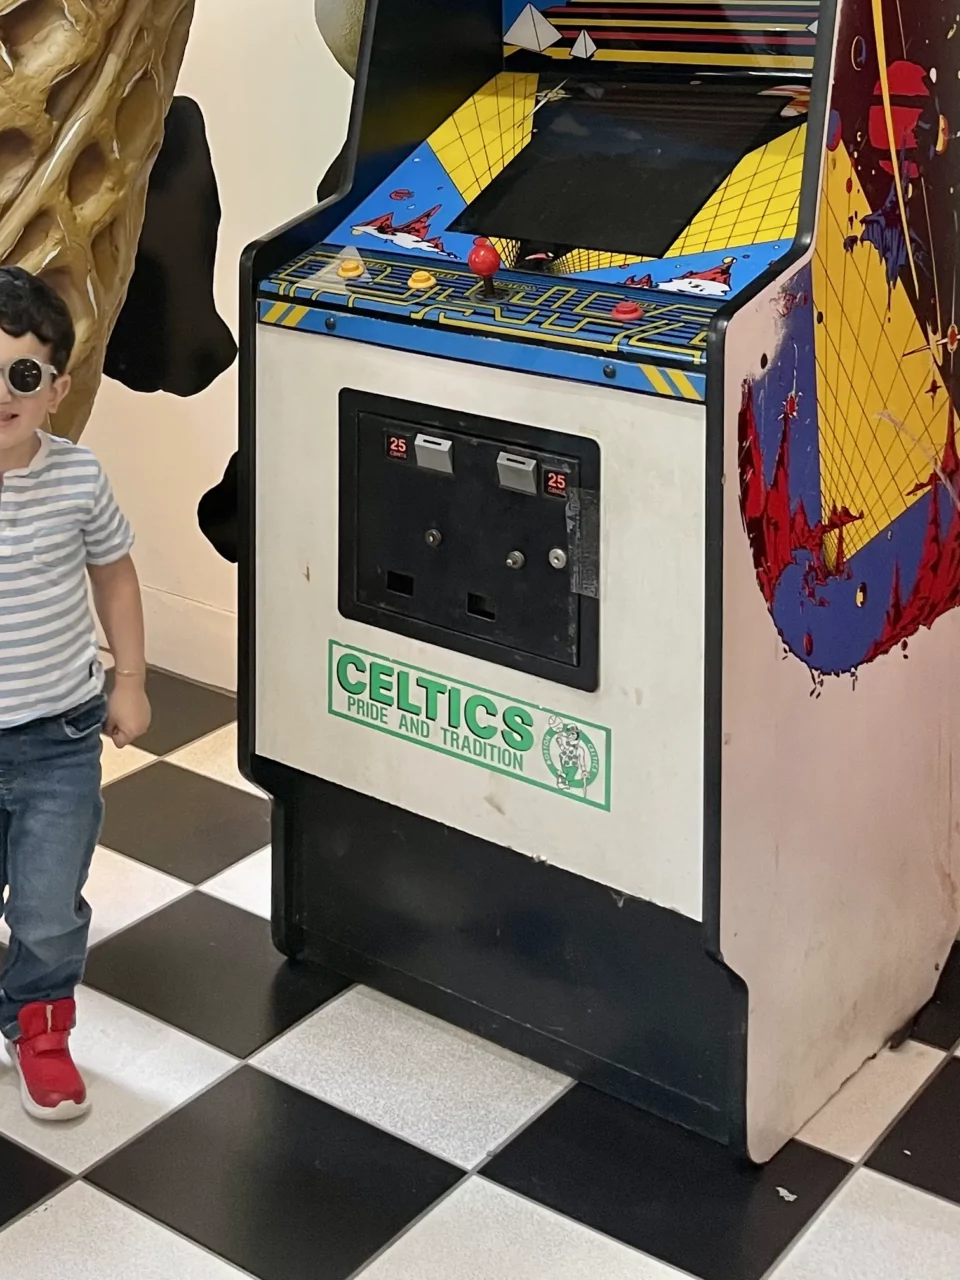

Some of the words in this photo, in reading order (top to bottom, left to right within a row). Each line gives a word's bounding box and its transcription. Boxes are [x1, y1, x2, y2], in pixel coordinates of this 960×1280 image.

[390, 438, 407, 452] 25
[548, 473, 566, 489] 25
[336, 653, 534, 752] CELTICS
[347, 696, 388, 724] PRIDE
[399, 714, 430, 738] AND
[440, 726, 524, 771] TRADITION
